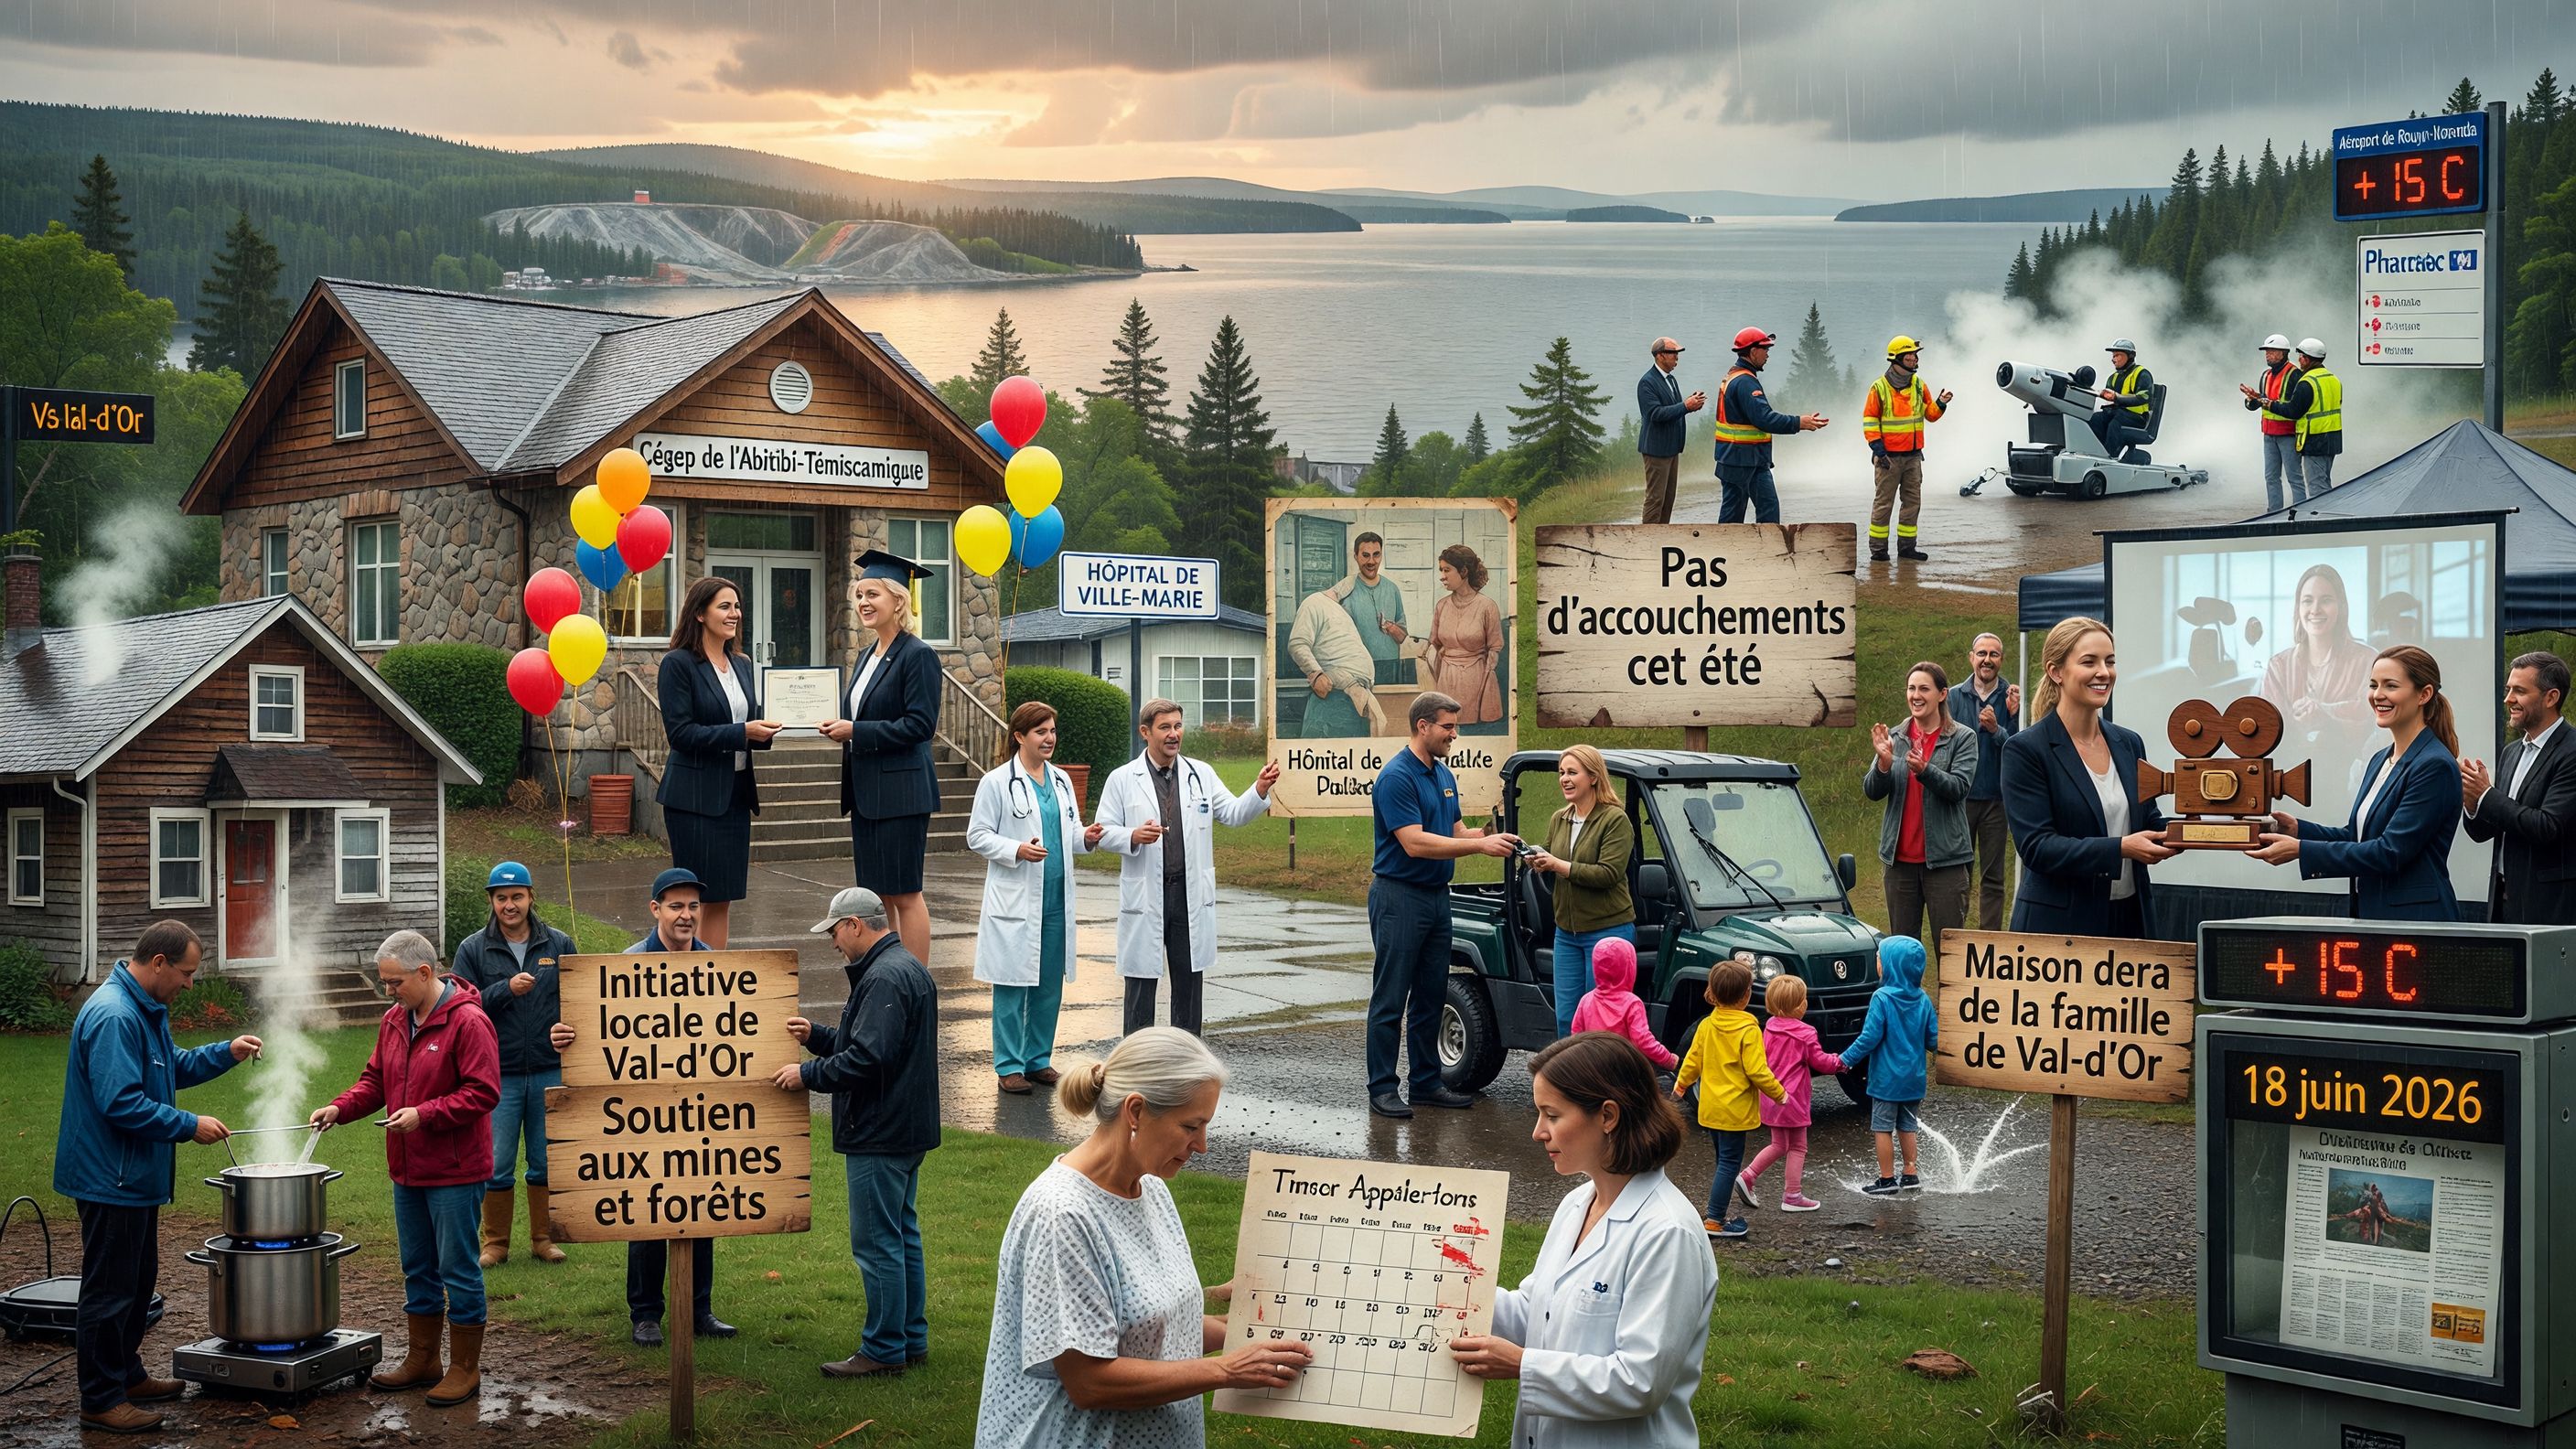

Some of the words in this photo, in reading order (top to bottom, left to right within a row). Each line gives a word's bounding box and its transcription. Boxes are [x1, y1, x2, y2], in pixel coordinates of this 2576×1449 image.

[2382, 130, 2395, 145] de
[640, 440, 695, 474] Cégep
[702, 444, 724, 469] de
[1088, 559, 1169, 584] HÔPITAL
[1176, 566, 1199, 585] DE
[1661, 546, 1728, 588] Pas
[1078, 585, 1203, 609] VILLE-MARIE
[1547, 595, 1846, 636] d'accouchements
[1627, 647, 1687, 685] cet
[1700, 642, 1762, 685] été
[1360, 749, 1382, 769] de
[599, 961, 757, 999] Initiative
[1965, 943, 2082, 983] Maison
[2094, 950, 2170, 990] dera
[600, 1002, 703, 1040] locale
[715, 1001, 758, 1036] de
[1959, 986, 2000, 1024] de
[2012, 989, 2039, 1027] la
[2051, 992, 2170, 1036] famille
[602, 1043, 754, 1081] Val-d'Or
[1964, 1032, 2006, 1069] de
[2015, 1036, 2163, 1081] Val-d'Or
[603, 1092, 756, 1135] Soutien
[2244, 1064, 2287, 1107] 18
[2295, 1068, 2366, 1121] juin
[2380, 1073, 2482, 1124] 2026
[577, 1148, 650, 1181] aux
[663, 1137, 782, 1178] mines
[595, 1189, 635, 1226] et
[647, 1181, 767, 1224] forêts
